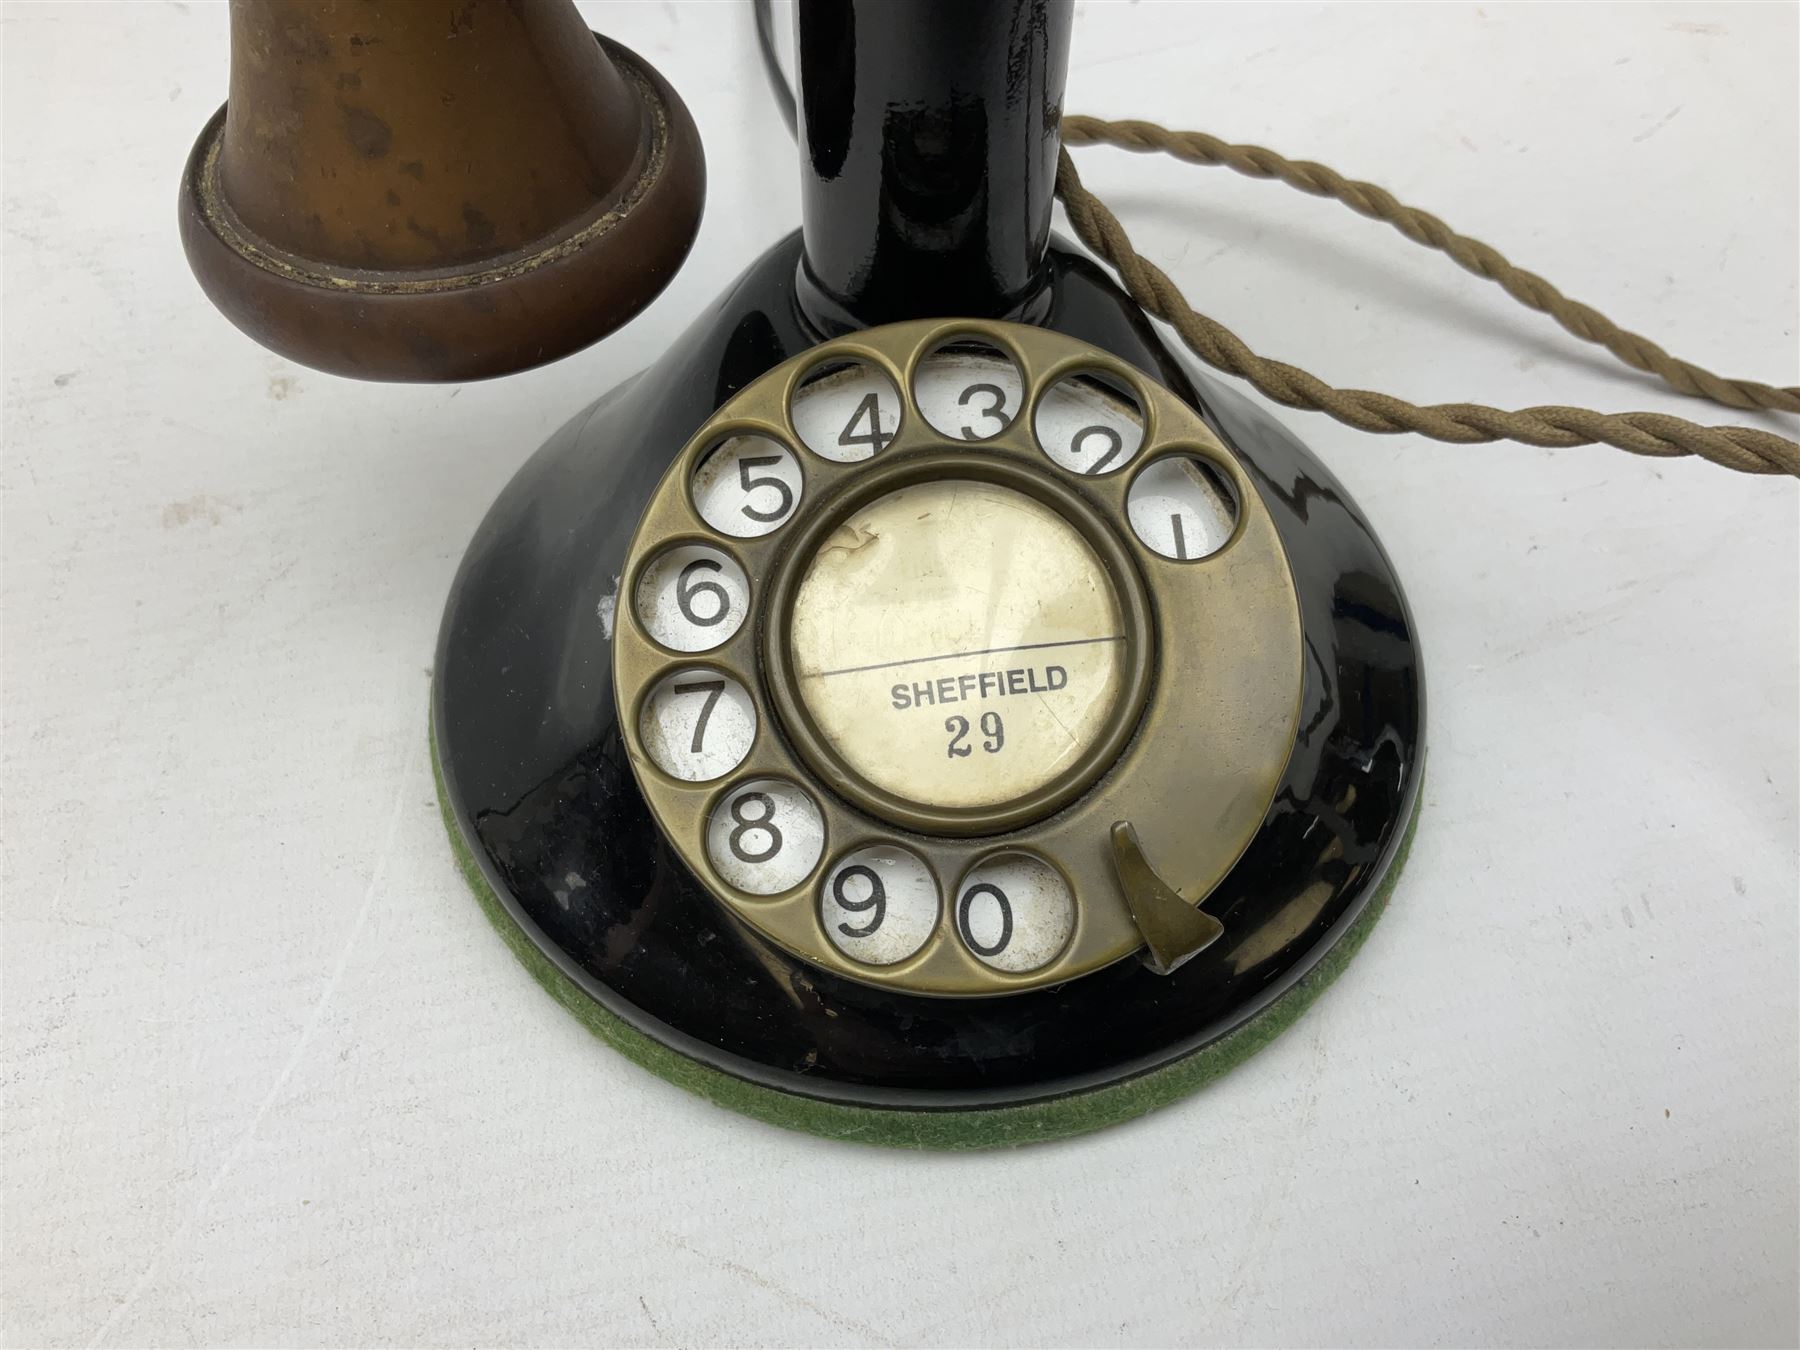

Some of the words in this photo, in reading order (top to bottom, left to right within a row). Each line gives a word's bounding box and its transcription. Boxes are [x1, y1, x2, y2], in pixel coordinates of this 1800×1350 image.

[838, 393, 893, 458] 4
[958, 383, 1010, 441] 3
[1071, 425, 1123, 475] 2
[738, 455, 793, 522] 5
[1171, 513, 1186, 560] 1
[675, 558, 730, 627] 6
[673, 680, 726, 754] 7
[890, 665, 1068, 710] SHEFFIELD
[944, 711, 1005, 759] 29
[728, 792, 783, 864] 8
[832, 865, 886, 938] 9
[958, 883, 1013, 957] 0
